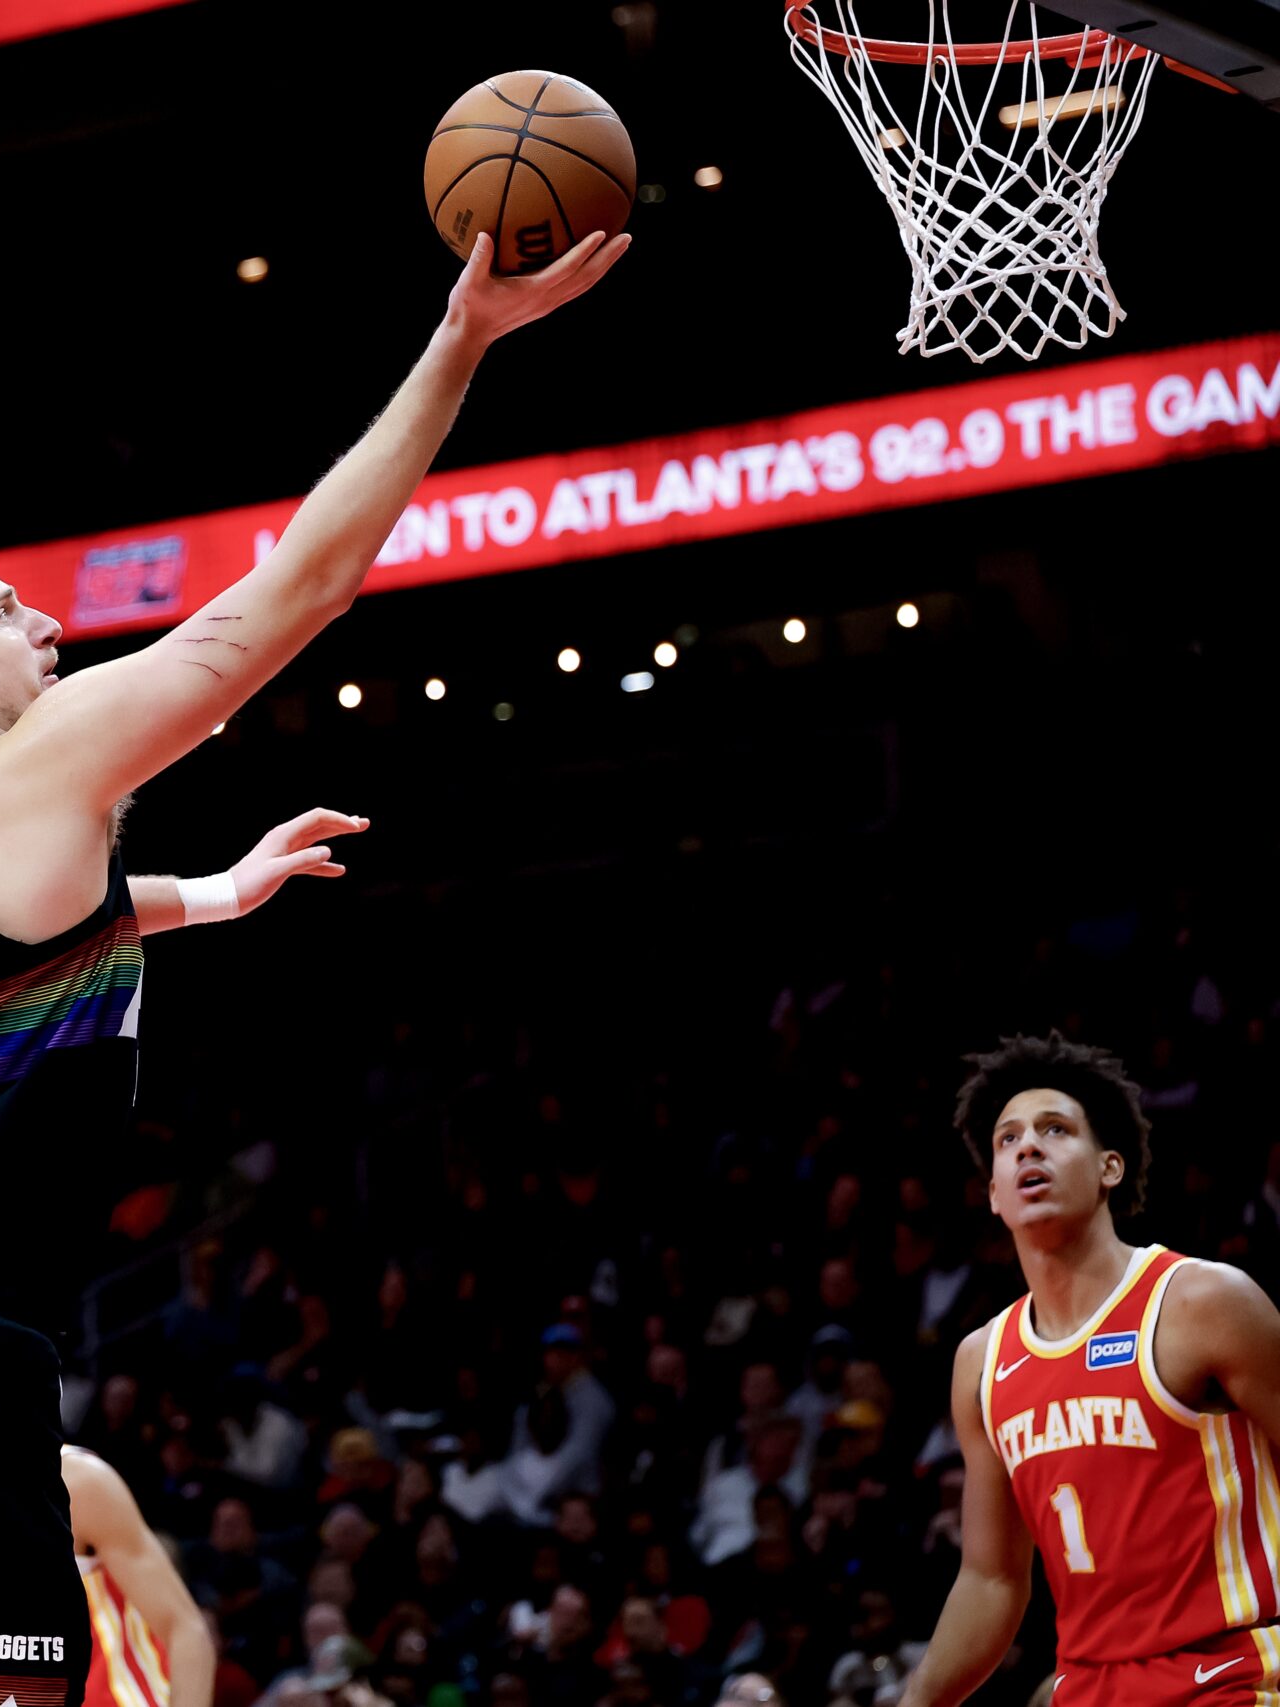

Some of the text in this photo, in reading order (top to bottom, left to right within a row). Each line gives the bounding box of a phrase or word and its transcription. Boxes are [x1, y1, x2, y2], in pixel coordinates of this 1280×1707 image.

[450, 487, 537, 547] TO
[540, 430, 865, 540] ATLANTA'S
[869, 408, 1005, 484] 92.9
[1005, 382, 1139, 459] THE
[1146, 358, 1280, 437] GAM
[1091, 1340, 1133, 1362] paze
[1050, 1482, 1095, 1573] 1
